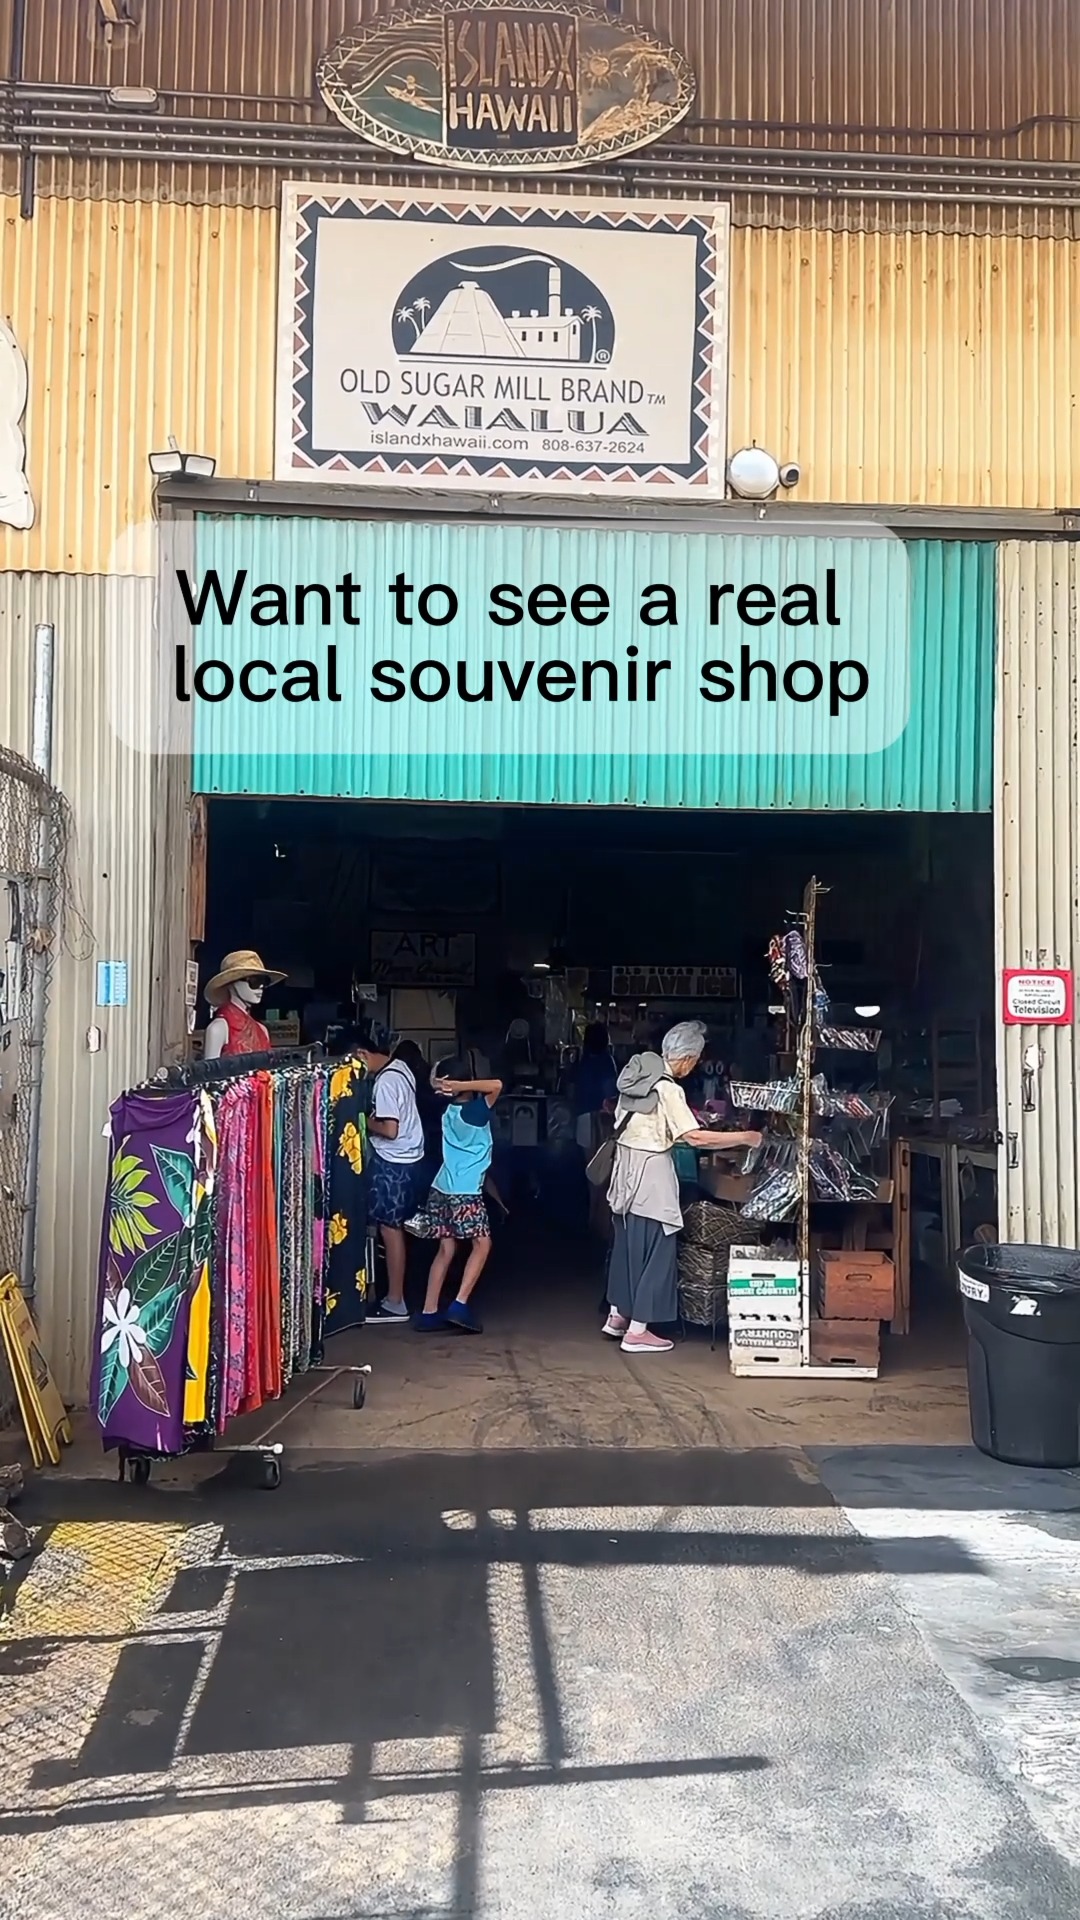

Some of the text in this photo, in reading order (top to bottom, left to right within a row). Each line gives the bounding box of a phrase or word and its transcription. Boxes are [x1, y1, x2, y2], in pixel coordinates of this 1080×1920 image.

[449, 19, 574, 90] ISLANDX
[449, 92, 573, 133] HAWAII
[340, 368, 391, 394] OLD
[401, 370, 485, 398] SUGAR
[495, 375, 552, 401] MILL
[562, 378, 644, 404] BRAND
[361, 401, 650, 437] WAIALUA
[370, 430, 645, 454] islandxhawaii.com 808-637-2624
[394, 931, 457, 957] ART
[1013, 1005, 1061, 1014] Television
[739, 1329, 794, 1339] COUNTRY
